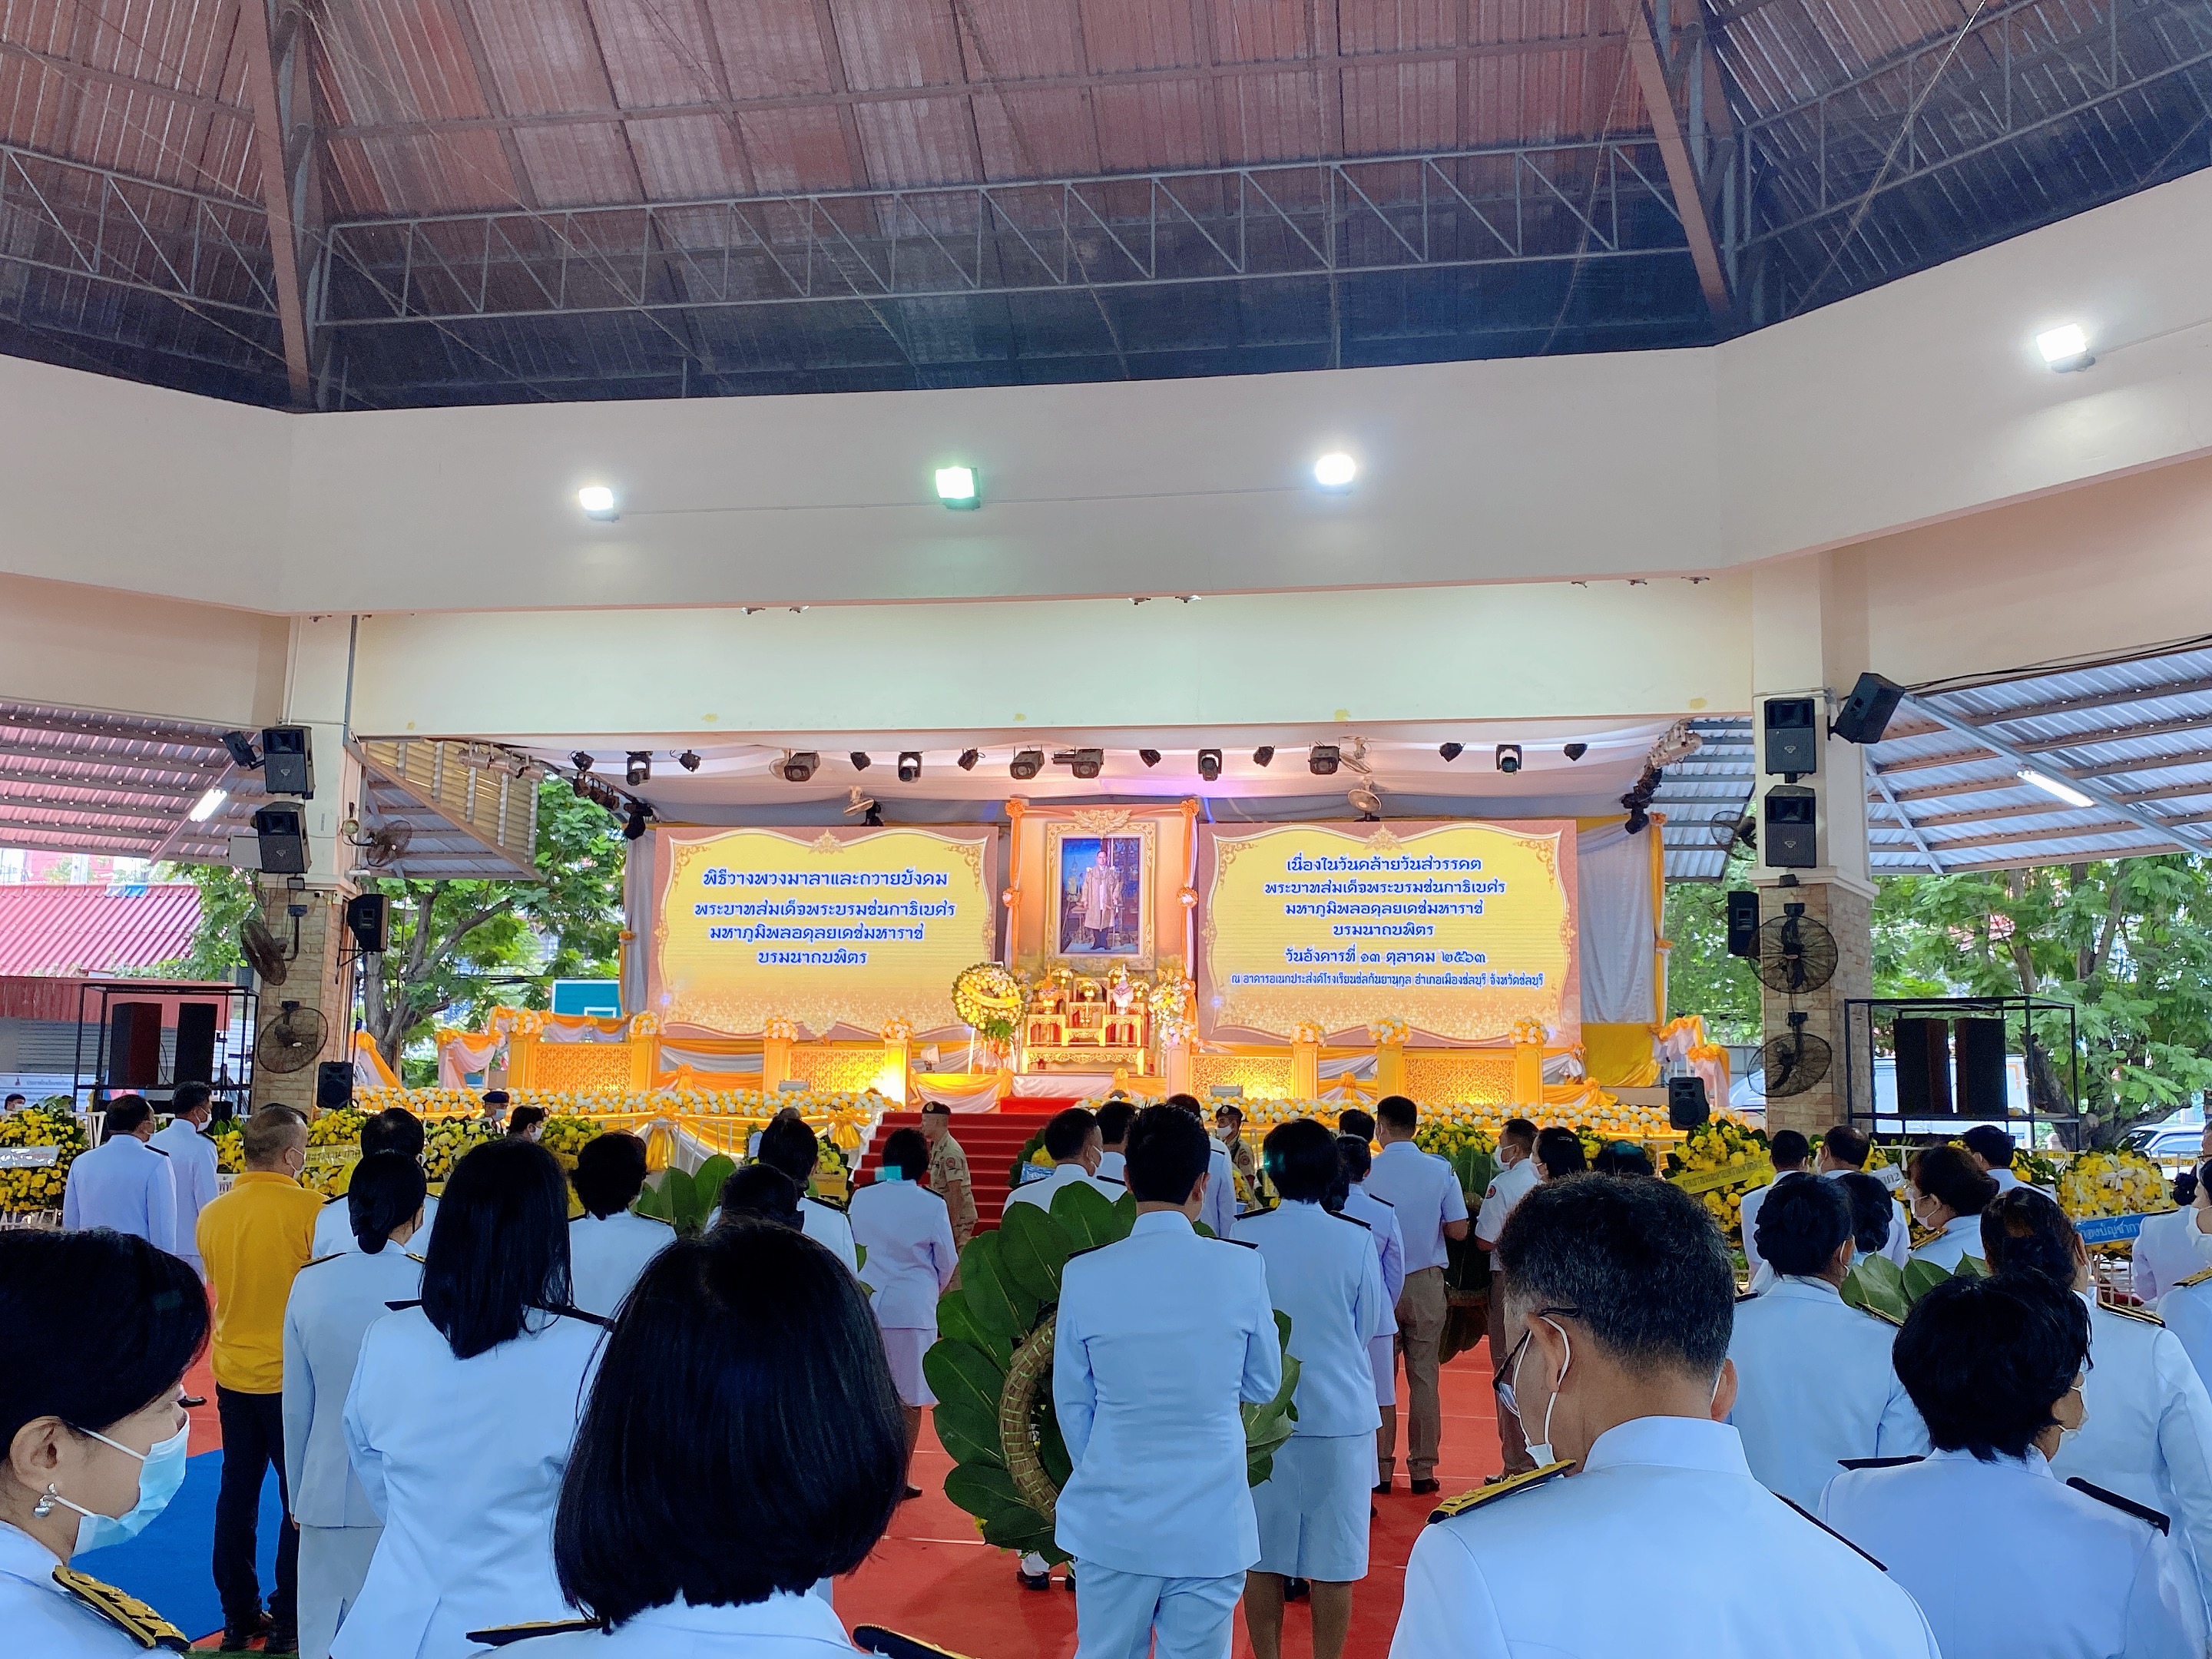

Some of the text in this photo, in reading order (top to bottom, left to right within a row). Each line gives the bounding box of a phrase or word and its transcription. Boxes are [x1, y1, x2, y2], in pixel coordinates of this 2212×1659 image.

[1287, 852, 1482, 871] เนื่องในวันคล้ายวันสวรรคต
[703, 868, 947, 886] พิธีวางพวงมาลาและถวายบังคม
[1264, 878, 1505, 894] พระบาทสมเด็จพระบรมชนกาธิเบศร
[694, 899, 955, 916] พระบาทสมเด็จพระบรมชนกาธิเบศร
[1286, 899, 1483, 918] มหาภูมิพลอดุลยเดชมหาราช
[710, 922, 924, 942] มหาภูมิพลอดุลยเดชมหาราช
[1333, 921, 1434, 935] บรมนาถบพิตร
[758, 948, 867, 964] บรมนาถบพิตร
[1285, 943, 1486, 966] วันอังคารที่ ๑๓ ตุลาคม ๒๕๖๓
[1231, 975, 1240, 984] ณ
[1414, 972, 1487, 988] อำเภอเมืองชลบุรี
[1489, 972, 1544, 988] จังหวัดชลบุรี
